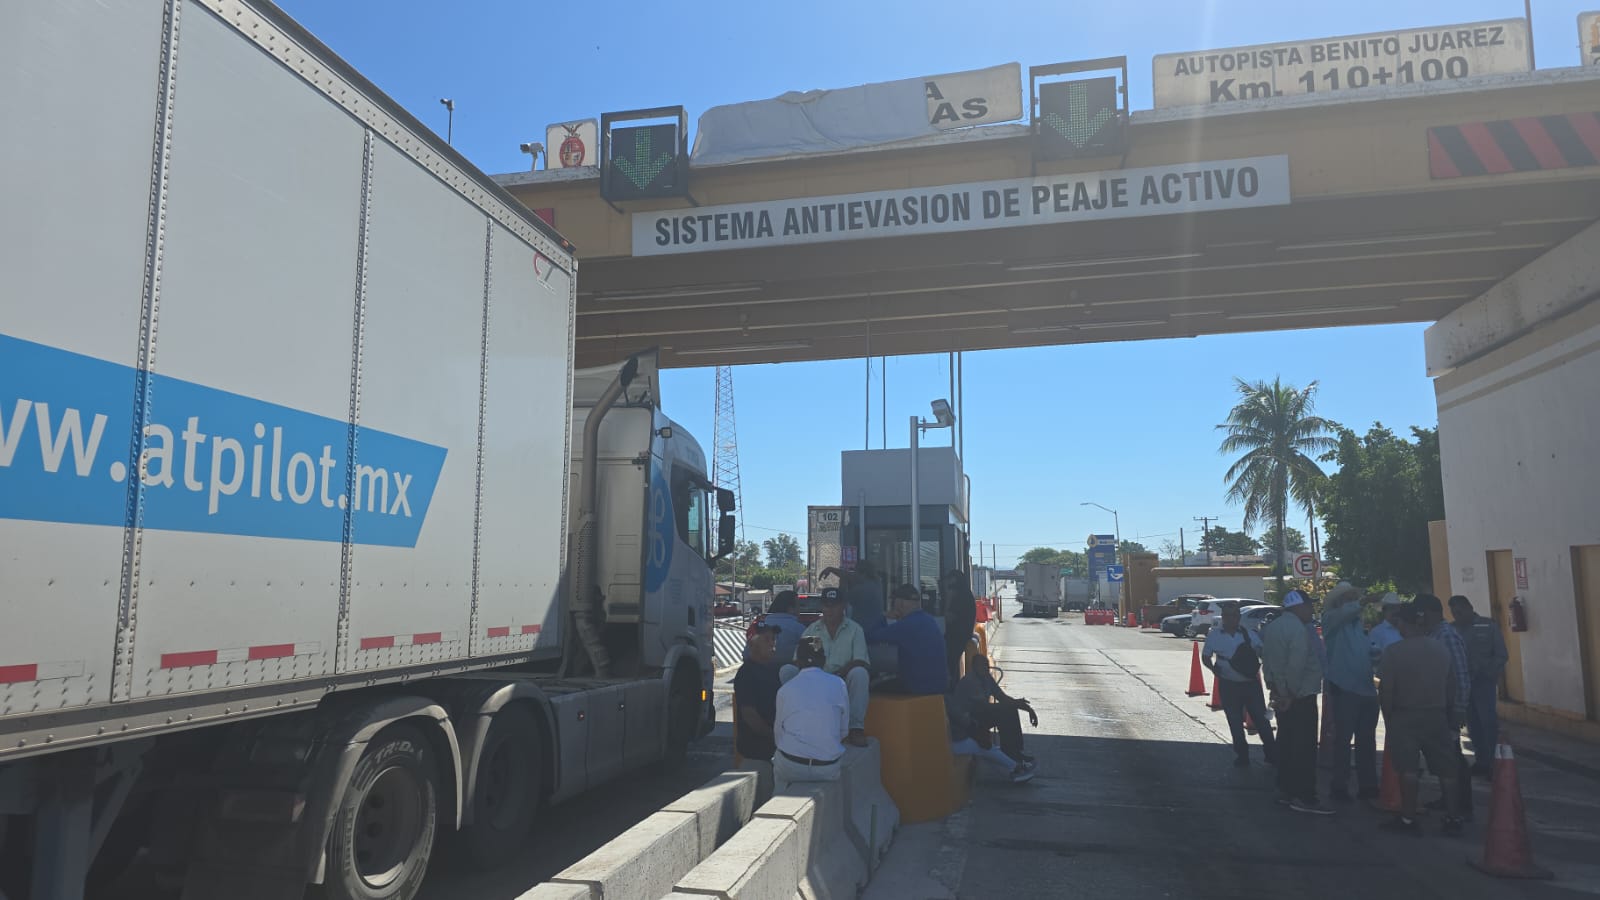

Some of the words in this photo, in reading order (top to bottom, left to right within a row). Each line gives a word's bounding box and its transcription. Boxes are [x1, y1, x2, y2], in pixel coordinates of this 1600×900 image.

[1174, 47, 1303, 76] AUTOPISTA
[1310, 37, 1400, 63] BENITO
[1408, 26, 1505, 53] JUAREZ
[1210, 78, 1283, 103] Km.
[1298, 56, 1469, 93] 110+100
[655, 210, 774, 246] SISTEMA
[783, 191, 970, 236] ANTIEVASION
[982, 187, 1020, 219] DE
[1032, 178, 1128, 215] PEAJE
[1140, 166, 1259, 206] ACTIVO
[1301, 558, 1314, 572] E
